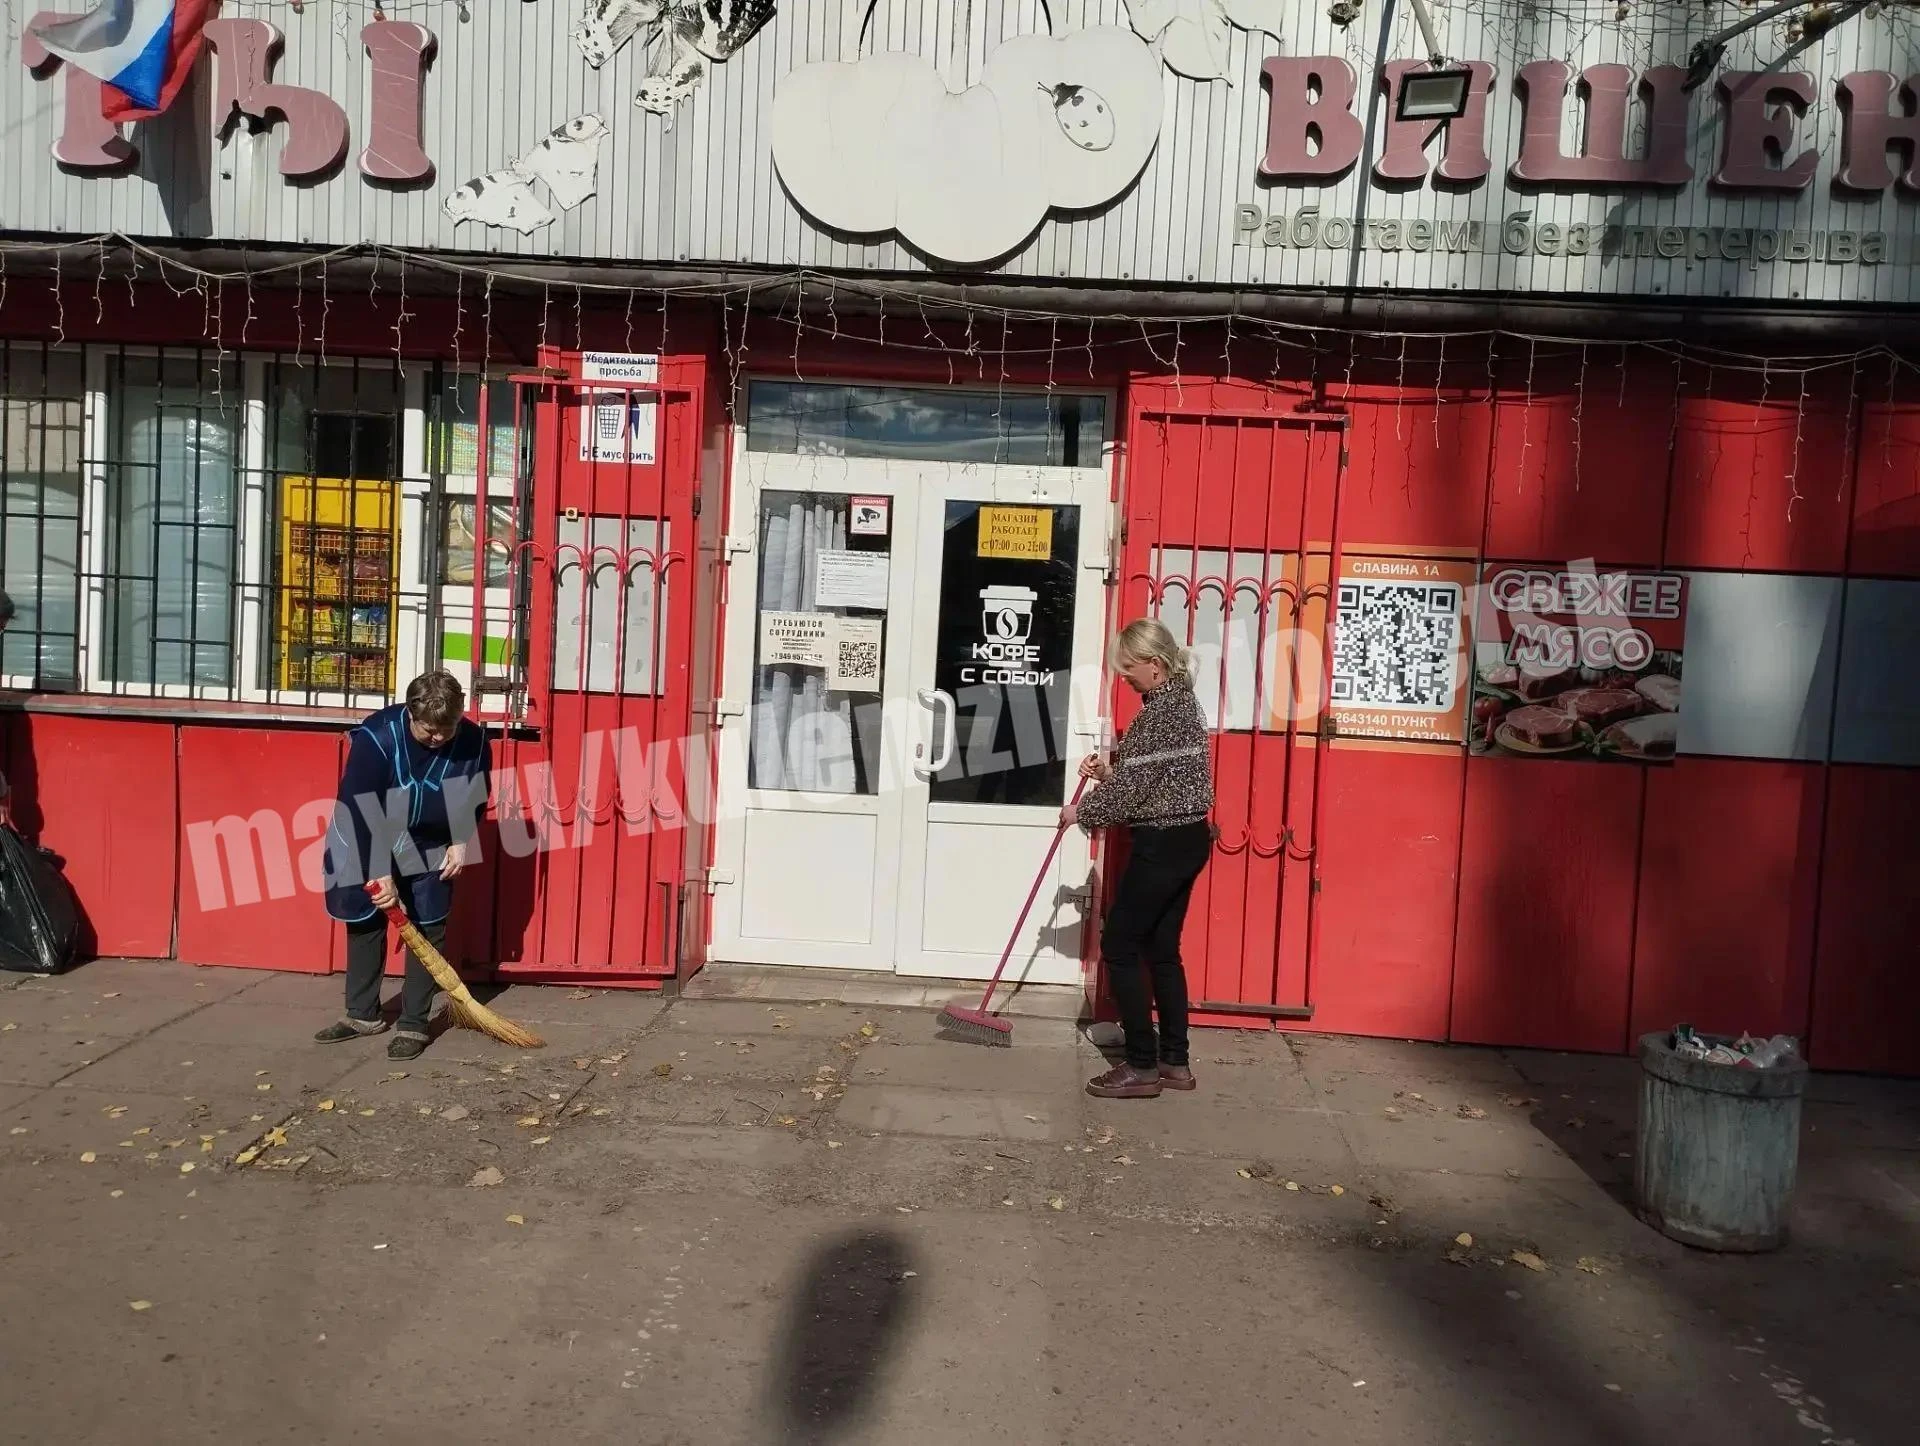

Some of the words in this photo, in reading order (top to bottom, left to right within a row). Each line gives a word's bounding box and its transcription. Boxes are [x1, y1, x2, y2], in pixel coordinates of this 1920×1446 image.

[1232, 202, 1470, 252] Работаем
[1503, 209, 1591, 257] без
[1621, 225, 1889, 271] перерыва
[584, 353, 657, 366] Убедительная
[599, 367, 642, 378] просьба
[602, 450, 654, 461] мусрить
[992, 513, 1038, 524] МАГАЗИН
[991, 525, 1040, 536] РАБОТАЕТ
[989, 539, 1011, 551] 07:00
[1026, 541, 1048, 553] 21:00
[1352, 561, 1419, 576] СЛАВИНА
[1423, 565, 1440, 577] 1А
[1490, 569, 1682, 619] СВЕЖЕЕ
[772, 618, 824, 628] ТРЕБУЮТСЯ
[769, 628, 826, 638] СОТРУДНИКИ
[972, 642, 1041, 663] КОФЕ
[1507, 622, 1655, 671] МЯСО
[960, 668, 976, 683] С
[982, 668, 1055, 687] СОБОЙ
[1391, 714, 1438, 729] ПУНКТ
